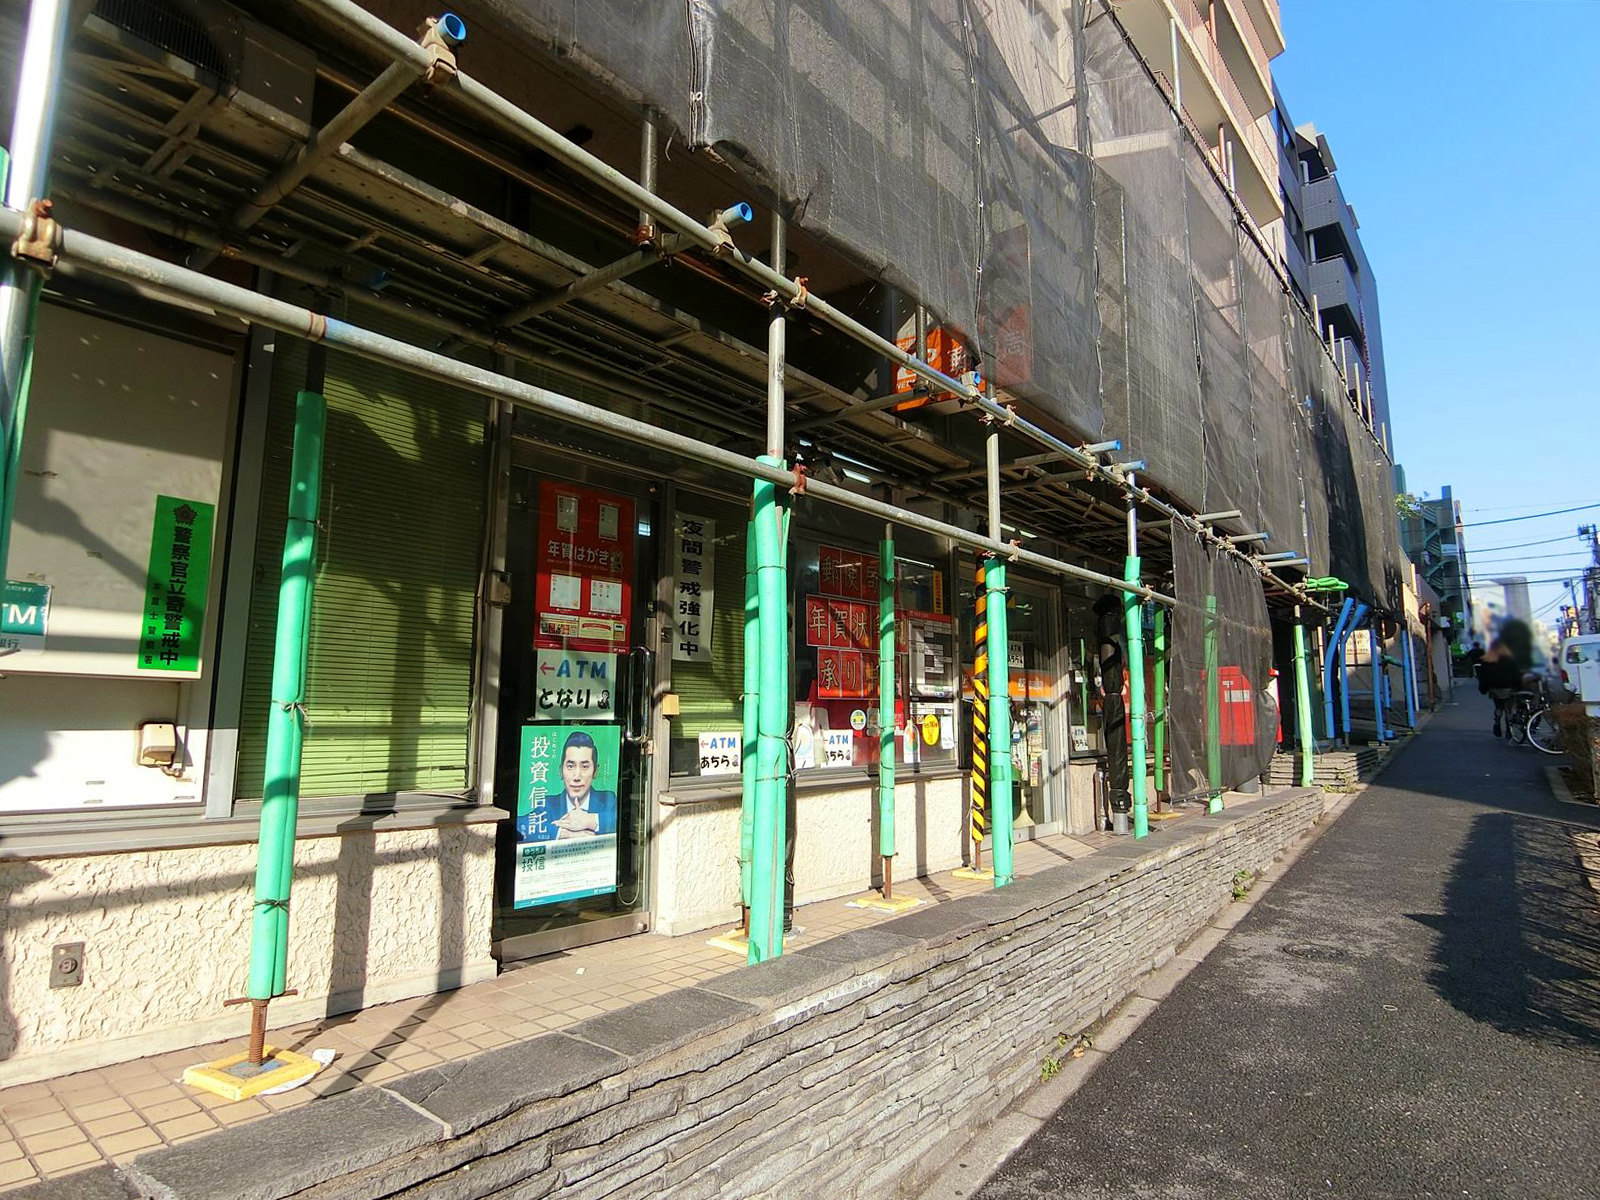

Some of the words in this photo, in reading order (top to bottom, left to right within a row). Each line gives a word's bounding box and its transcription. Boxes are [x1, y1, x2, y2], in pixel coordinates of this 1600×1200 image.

[548, 539, 609, 565] 年賀はがき
[160, 526, 193, 666] 警察官立寄警戒中
[679, 519, 704, 656] 夜間警戒強化中
[557, 660, 607, 679] ATM
[540, 688, 590, 709] となり
[710, 737, 736, 749] ATM
[829, 735, 848, 745] ATM
[701, 754, 730, 769] あちら
[528, 736, 551, 834] 投資信託
[522, 856, 545, 873] 投信
